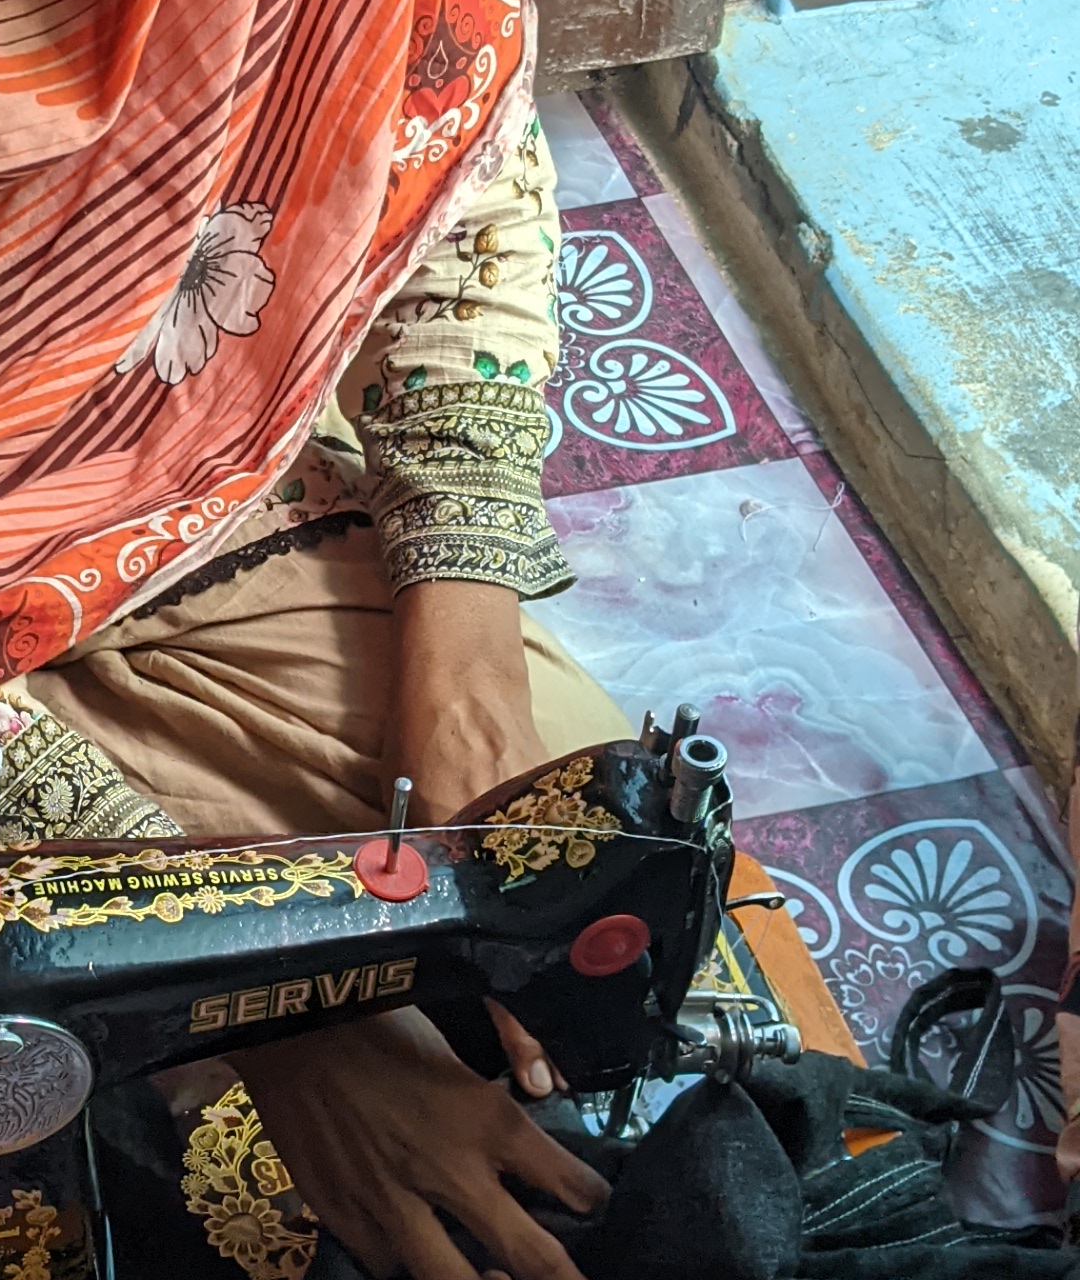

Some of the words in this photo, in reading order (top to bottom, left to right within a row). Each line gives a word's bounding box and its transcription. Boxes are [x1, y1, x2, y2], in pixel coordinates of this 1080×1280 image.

[127, 871, 203, 890] SEWING
[211, 868, 279, 885] SERVIS
[34, 877, 122, 896] MACHINE
[189, 957, 418, 1033] SERVIS
